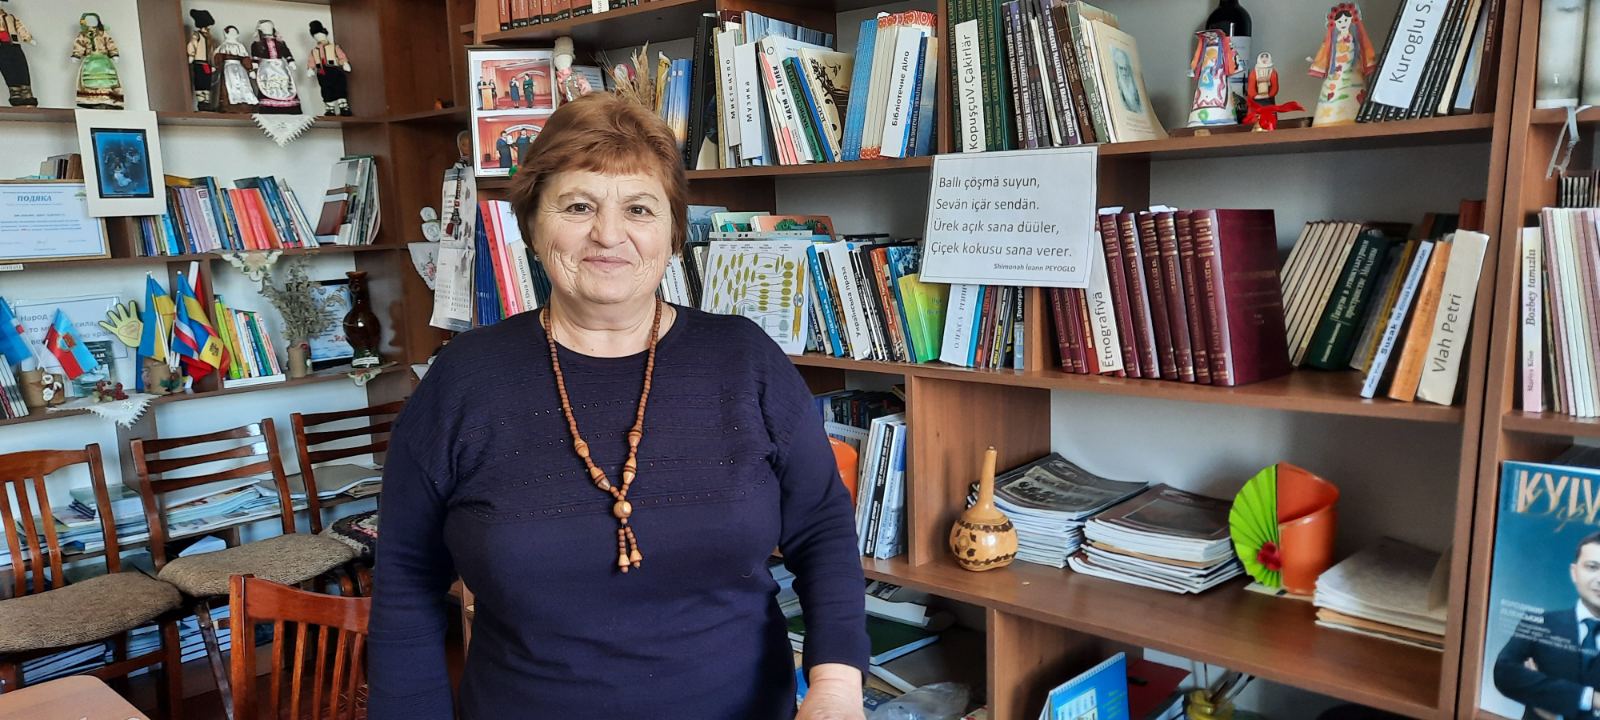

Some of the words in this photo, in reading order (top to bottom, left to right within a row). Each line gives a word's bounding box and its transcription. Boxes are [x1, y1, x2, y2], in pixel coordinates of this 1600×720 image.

[1389, 18, 1425, 83] Kuroglu
[772, 65, 784, 87] ТЕЛЕК
[725, 59, 737, 120] Мистецтво
[782, 98, 793, 120] ИДЕМ
[939, 176, 961, 188] Ballı
[964, 176, 999, 190] çöşmä
[1002, 177, 1040, 190] suyun,
[936, 199, 967, 210] Sevän
[971, 199, 991, 213] içär
[994, 199, 1039, 210] sendän.
[933, 218, 959, 232] Ürek
[962, 220, 983, 234] açık
[987, 223, 1013, 232] sana
[1017, 220, 1059, 235] düüler,
[931, 241, 959, 255] Çiçek
[962, 242, 1002, 255] kokusu
[1005, 246, 1033, 256] sana
[1036, 247, 1072, 257] verer.
[847, 292, 862, 338] Українська
[1380, 323, 1398, 355] Susak
[1432, 337, 1453, 373] Vlah
[1443, 294, 1462, 334] Petri
